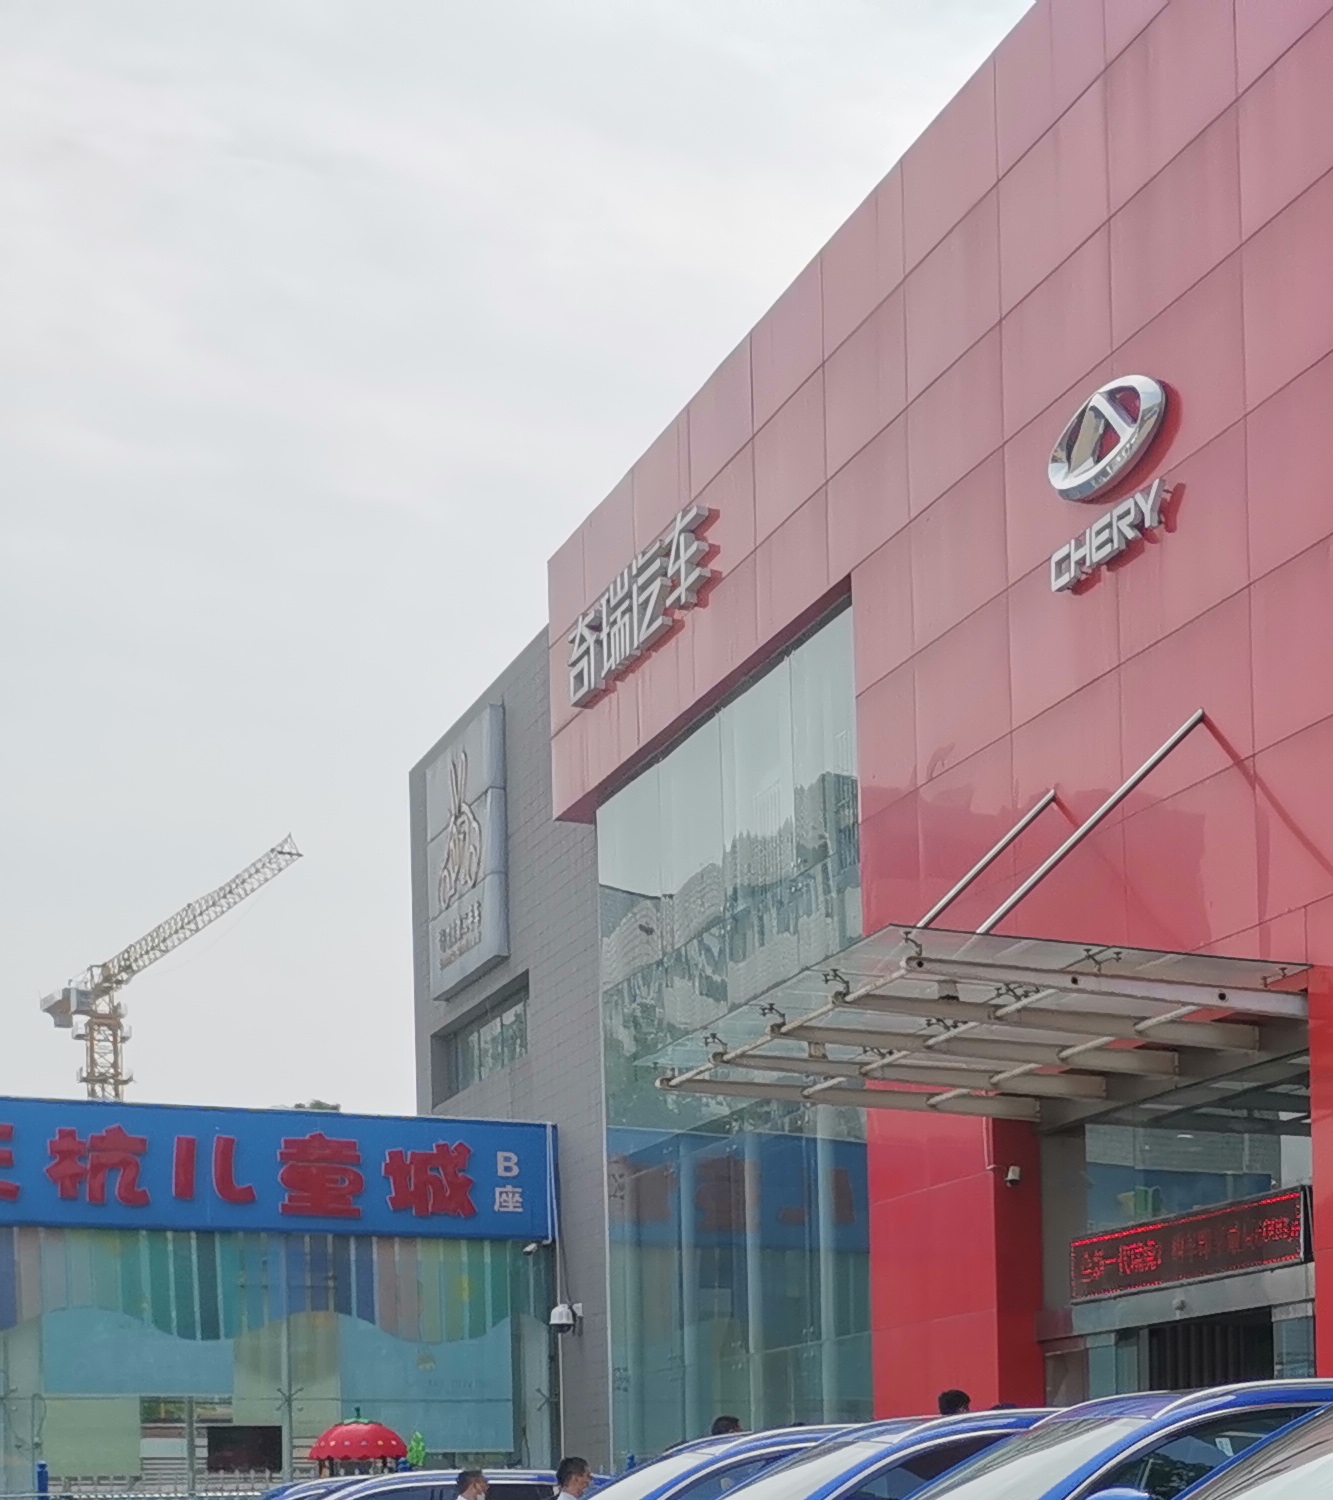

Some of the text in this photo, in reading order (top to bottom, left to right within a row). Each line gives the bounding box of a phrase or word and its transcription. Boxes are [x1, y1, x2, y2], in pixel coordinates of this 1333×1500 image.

[1051, 478, 1166, 592] CHERY
[567, 506, 710, 706] 奇瑞汽车
[0, 1124, 477, 1219] 杭儿童城
